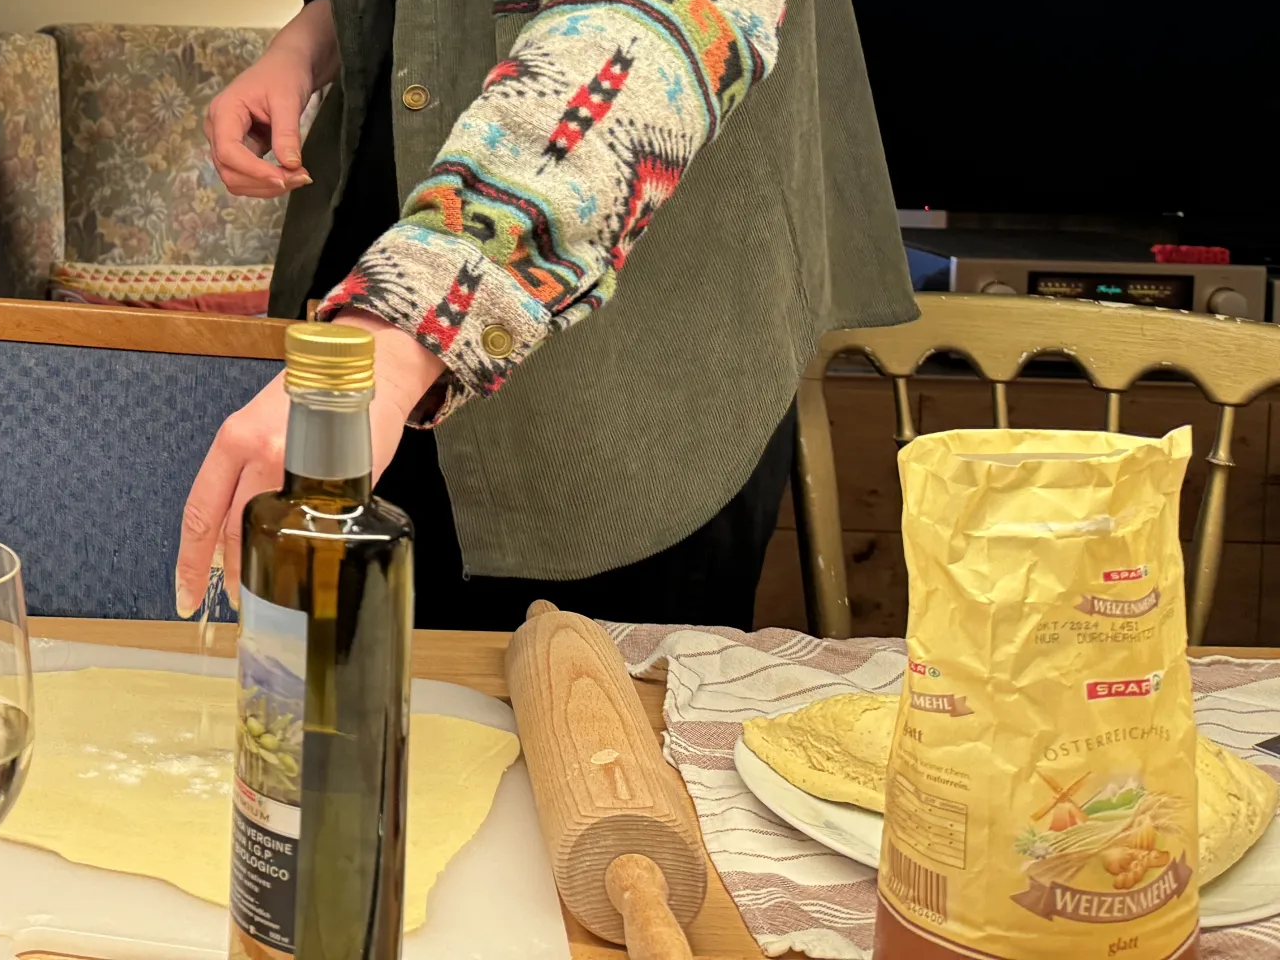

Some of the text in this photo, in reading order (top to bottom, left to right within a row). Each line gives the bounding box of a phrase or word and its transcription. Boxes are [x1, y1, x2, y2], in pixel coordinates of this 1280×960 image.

[1034, 632, 1060, 644] NUR
[912, 694, 953, 710] MEHL
[247, 825, 293, 856] VERGINE
[248, 840, 274, 863] I.G.P.
[1055, 870, 1178, 918] WEIZENMEHL
[1107, 936, 1139, 957] glatt
